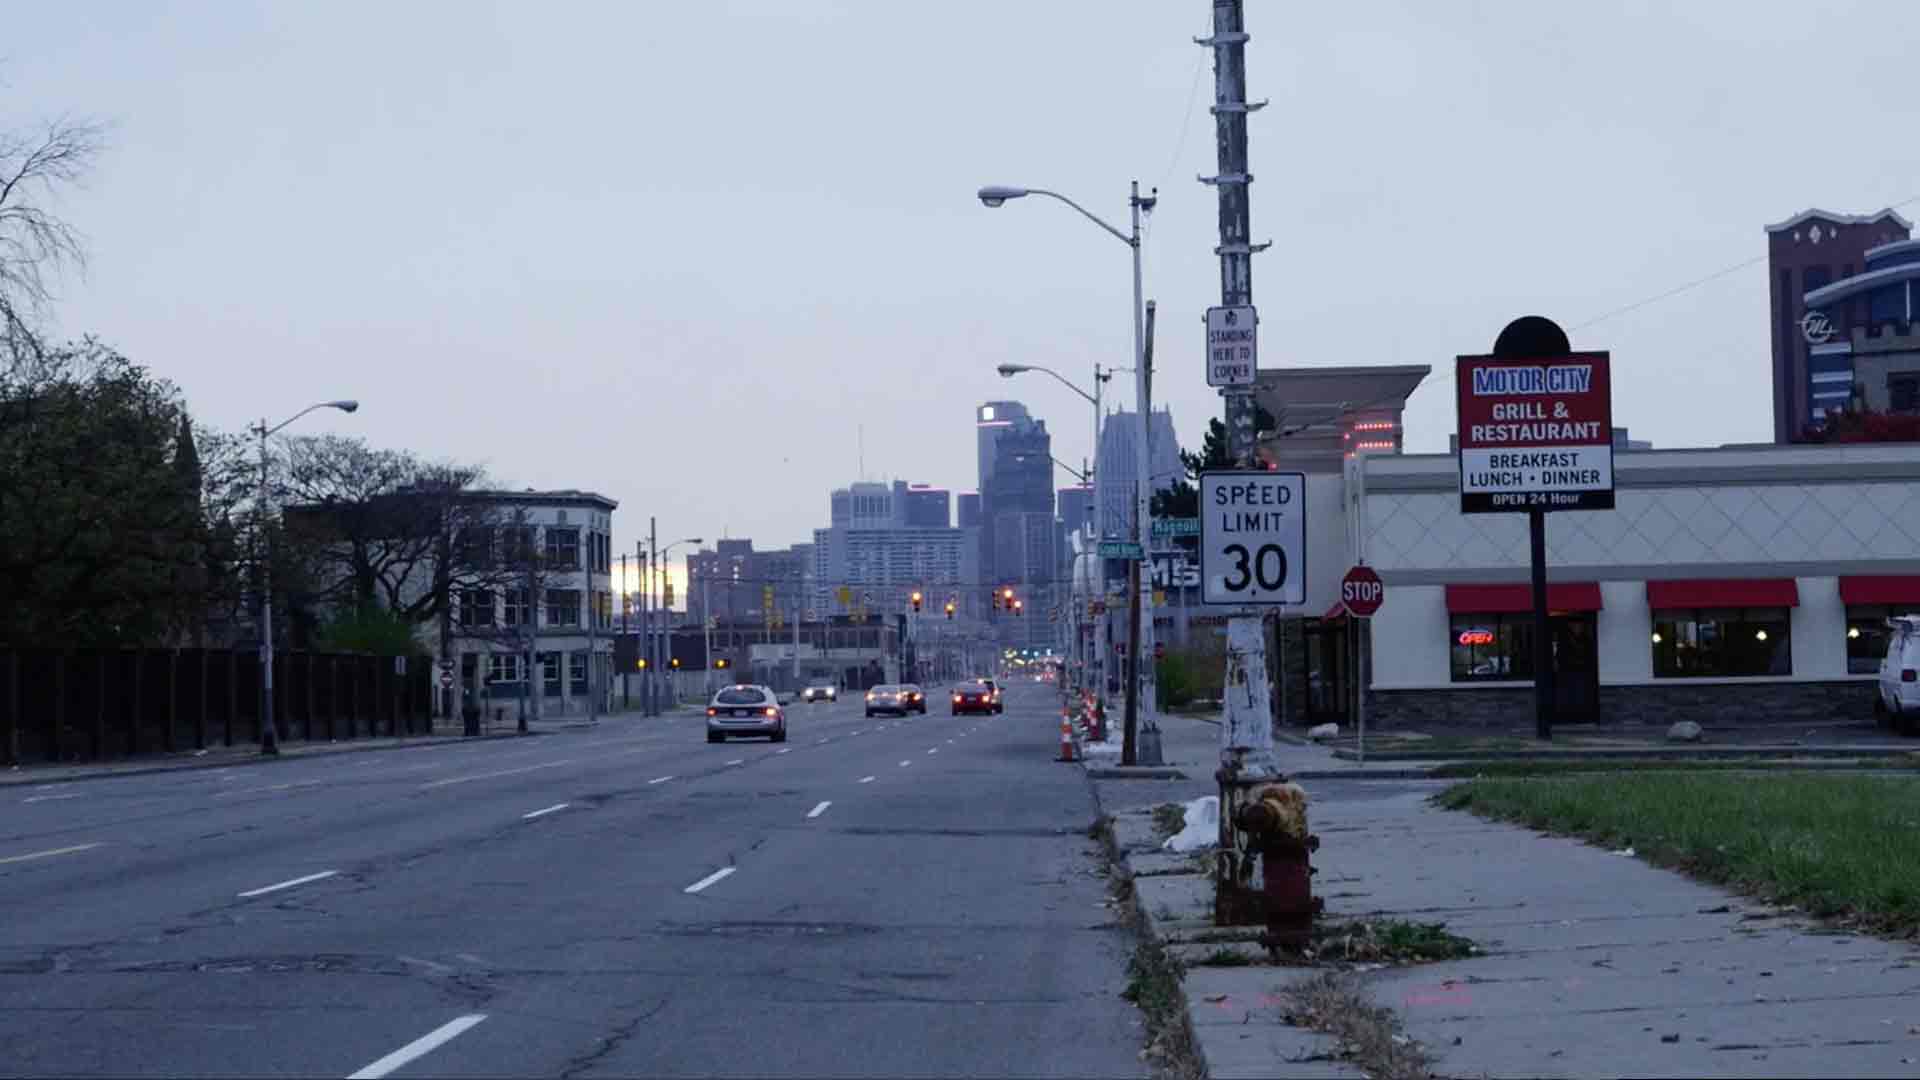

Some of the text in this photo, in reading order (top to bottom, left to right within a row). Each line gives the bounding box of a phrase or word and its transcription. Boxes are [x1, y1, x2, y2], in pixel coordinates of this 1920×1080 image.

[1210, 329, 1252, 343] STANDING
[1213, 346, 1251, 361] HERE TO
[1214, 364, 1249, 378] CORNER
[1473, 365, 1592, 395] MOTOR CITY
[1493, 401, 1569, 420] GRILL &
[1471, 422, 1601, 442] RESTAURANT
[1490, 453, 1579, 469] BREAKFAST
[1469, 469, 1600, 487] LUNCH DINNER
[1216, 485, 1291, 505] SPEED
[1492, 492, 1579, 505] OPEN 24 Hour
[1223, 512, 1283, 532] LIMIT
[1223, 543, 1288, 592] 30
[1343, 581, 1382, 601] STOP
[1459, 629, 1494, 645] OPEN
